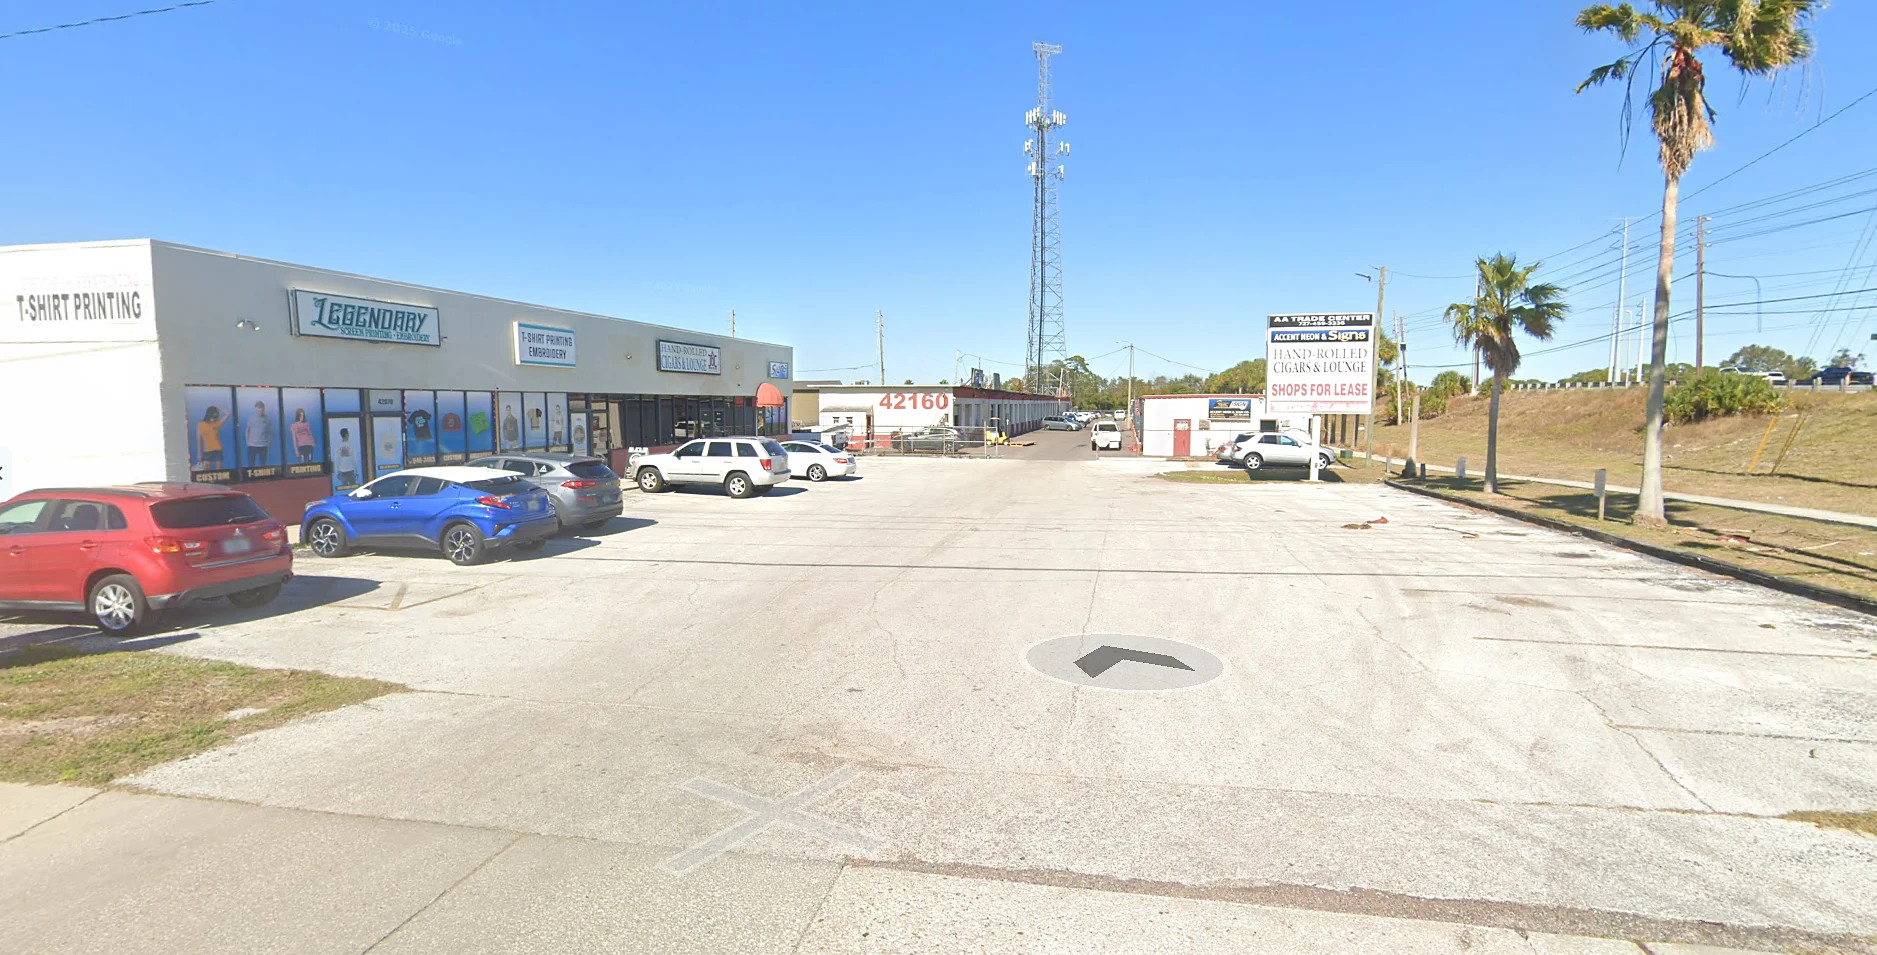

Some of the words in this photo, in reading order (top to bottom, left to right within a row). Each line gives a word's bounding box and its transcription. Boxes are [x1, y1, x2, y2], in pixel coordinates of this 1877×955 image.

[16, 293, 69, 321] T-SHIRT
[73, 291, 141, 320] PRINTING
[311, 297, 427, 332] LEGENDARY
[340, 326, 364, 336] SCREEN
[365, 329, 392, 339] PRINTING
[396, 332, 430, 342] EMBROIDERY
[521, 331, 544, 343] T-SHIRT
[546, 334, 572, 347] PRINTING
[1274, 333, 1300, 341] ACCENT
[1301, 333, 1320, 341] NEON
[1321, 333, 1327, 341] &
[1328, 330, 1365, 341] Signs
[528, 346, 567, 360] EMBROIDERY
[661, 343, 707, 357] HAND-ROLLED
[1273, 348, 1367, 359] HAND-ROLLED
[661, 355, 681, 369] CIGARS
[1273, 361, 1311, 373] CIGARS
[1313, 361, 1321, 373] &
[1323, 361, 1367, 373] LOUNGE
[1271, 383, 1308, 397] SHOPS
[1310, 383, 1331, 396] FOR
[1334, 383, 1368, 396] LEASE
[879, 392, 949, 410] 42160
[196, 471, 230, 481] CUSTOM
[247, 467, 275, 477] T-SHIRT
[291, 465, 321, 474] PRINTING
